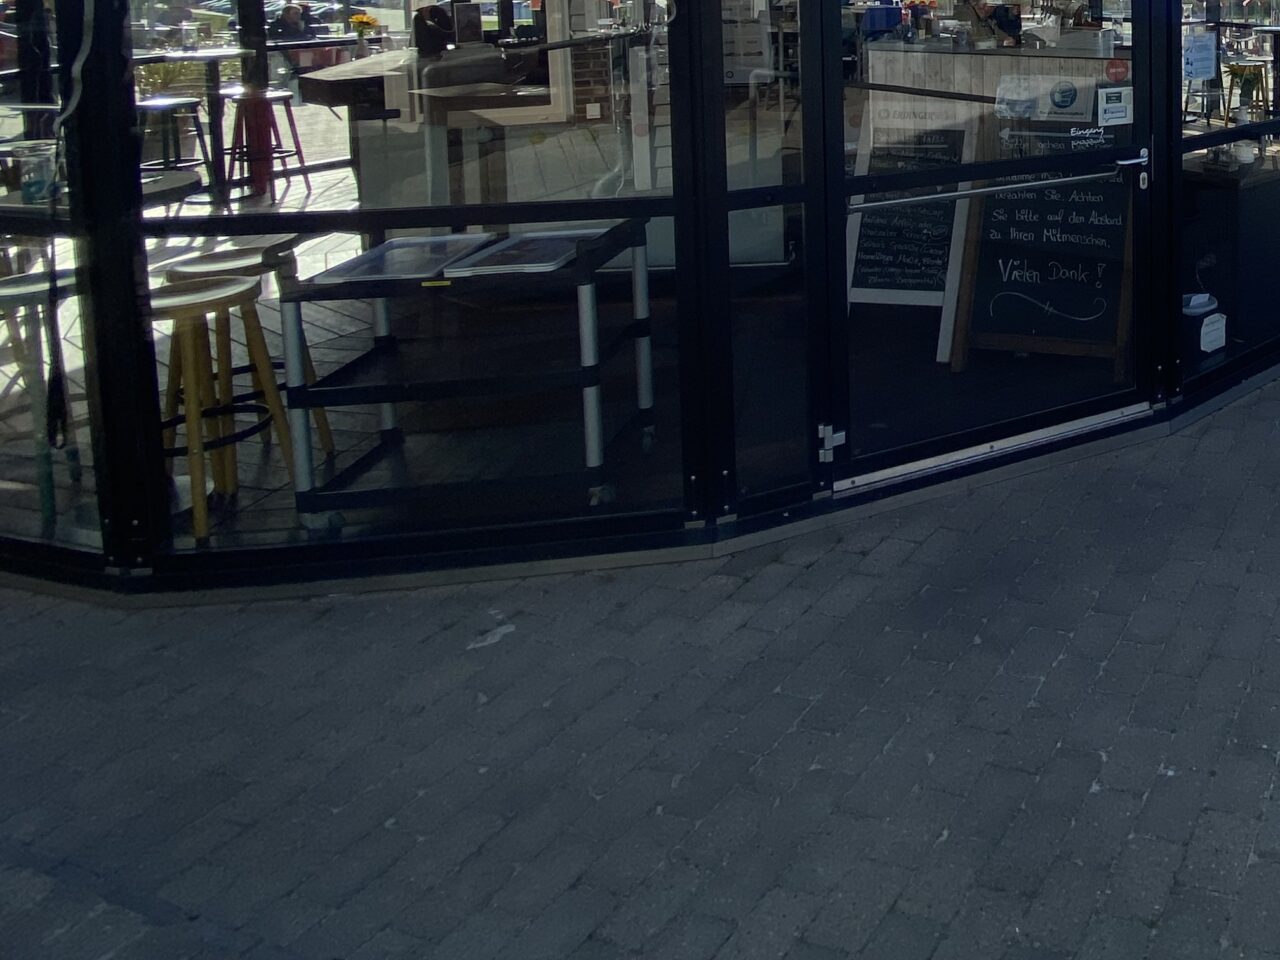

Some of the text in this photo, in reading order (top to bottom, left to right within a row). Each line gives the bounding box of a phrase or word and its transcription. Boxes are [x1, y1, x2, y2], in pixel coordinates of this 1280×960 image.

[1068, 191, 1104, 202] Achten
[991, 208, 1122, 226] Sie bitte auf den Abstand
[989, 229, 1001, 240] zu
[1010, 227, 1035, 241] Ihren
[998, 258, 1041, 284] Vielen
[1047, 261, 1089, 283] Dank
